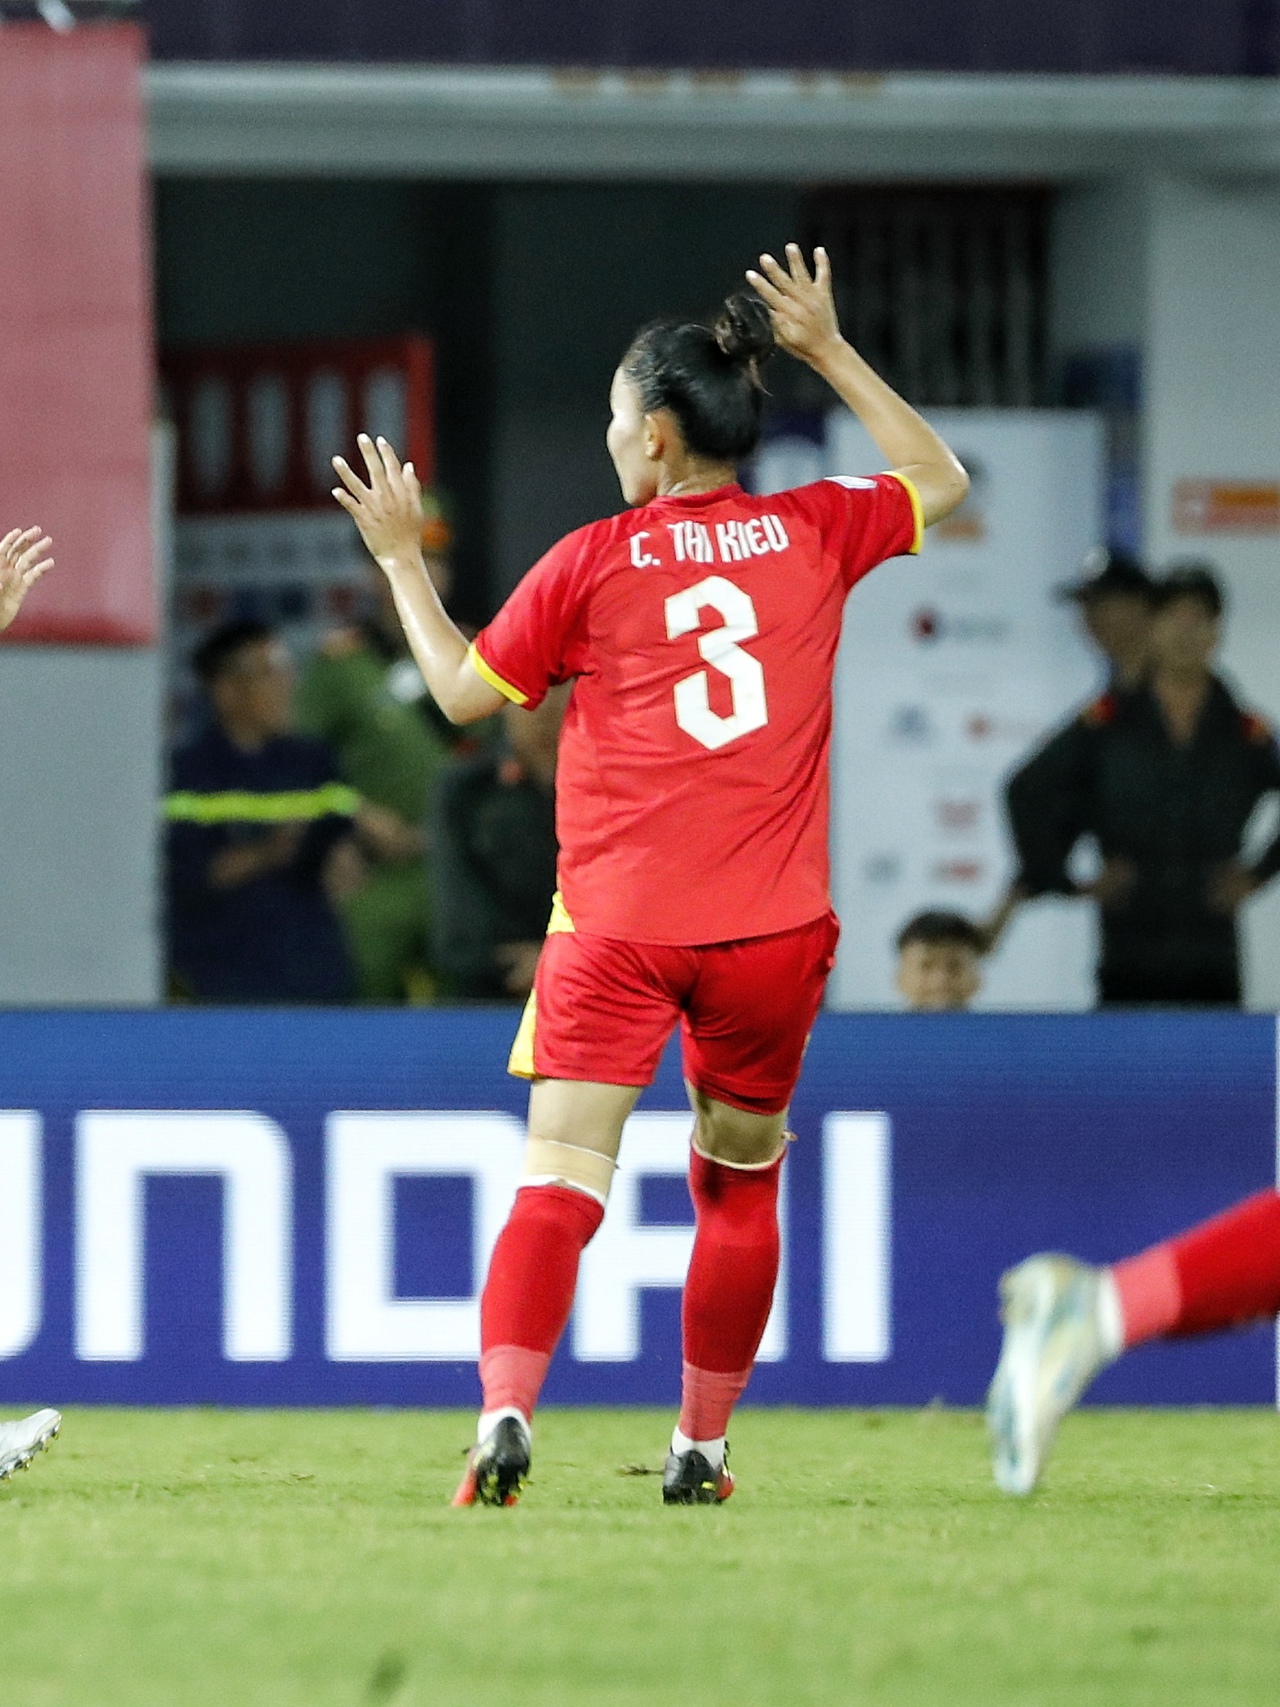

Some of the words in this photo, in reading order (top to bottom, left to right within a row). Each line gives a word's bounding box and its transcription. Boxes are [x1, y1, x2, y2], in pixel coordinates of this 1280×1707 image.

[629, 531, 662, 568] C.
[715, 514, 790, 563] KIEU
[663, 575, 769, 751] 3
